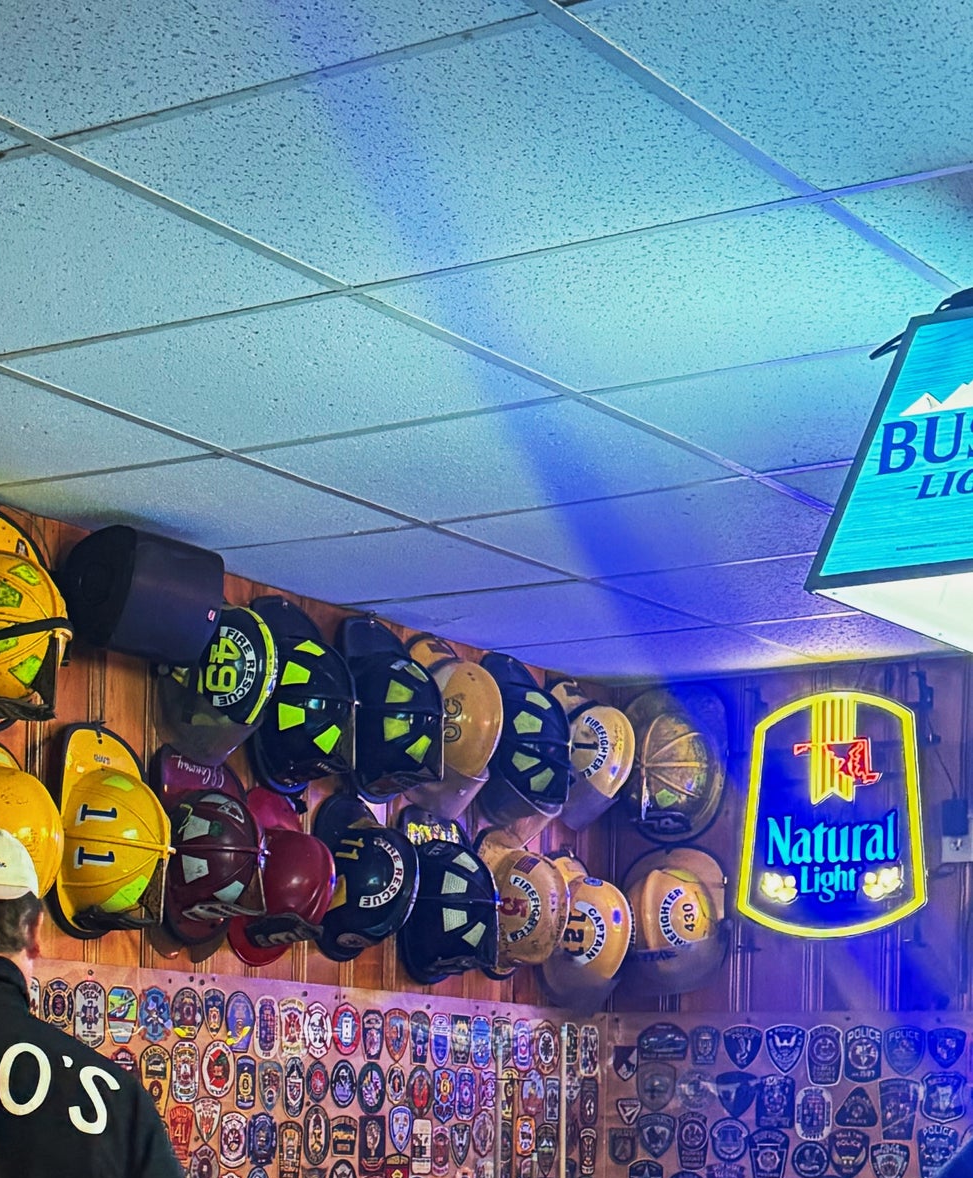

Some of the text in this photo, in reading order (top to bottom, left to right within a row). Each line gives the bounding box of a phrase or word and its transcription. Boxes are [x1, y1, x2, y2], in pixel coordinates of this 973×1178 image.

[205, 637, 242, 694] 49
[218, 627, 255, 706] FIRE RESCUE
[584, 716, 610, 771] FIREFIGHTER
[76, 803, 119, 870] 11
[766, 808, 899, 868] Natural
[362, 866, 404, 907] RESCUE
[800, 866, 858, 903] Light
[500, 896, 529, 918] 5
[510, 876, 540, 942] FIREFIGHTER
[660, 887, 685, 946] REFIGHTER
[682, 903, 696, 932] 430
[585, 907, 605, 960] CAPTAIN
[79, 983, 103, 997] VIRGINIA
[82, 992, 99, 1002] TECH
[847, 1028, 882, 1044] POLICE
[888, 1030, 921, 1042] POLICE
[173, 1123, 188, 1145] 41
[835, 1139, 863, 1148] POLICE
[921, 1125, 956, 1137] POLICE
